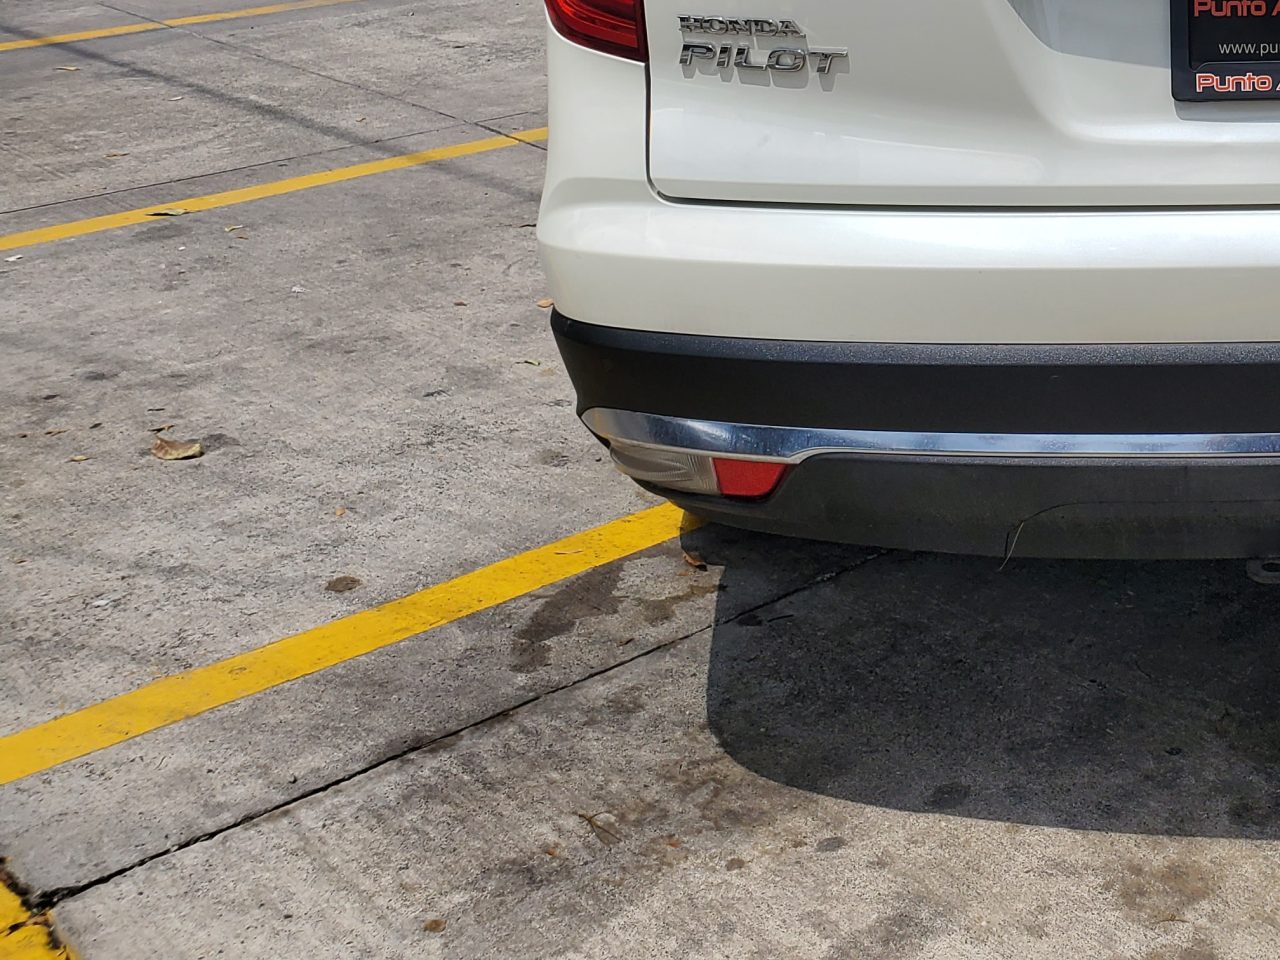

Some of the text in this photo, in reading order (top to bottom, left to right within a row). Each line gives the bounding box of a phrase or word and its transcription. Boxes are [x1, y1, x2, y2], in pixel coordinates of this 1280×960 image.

[677, 15, 807, 38] HONDA
[679, 42, 849, 74] PILOT
[1195, 73, 1273, 93] Punto
